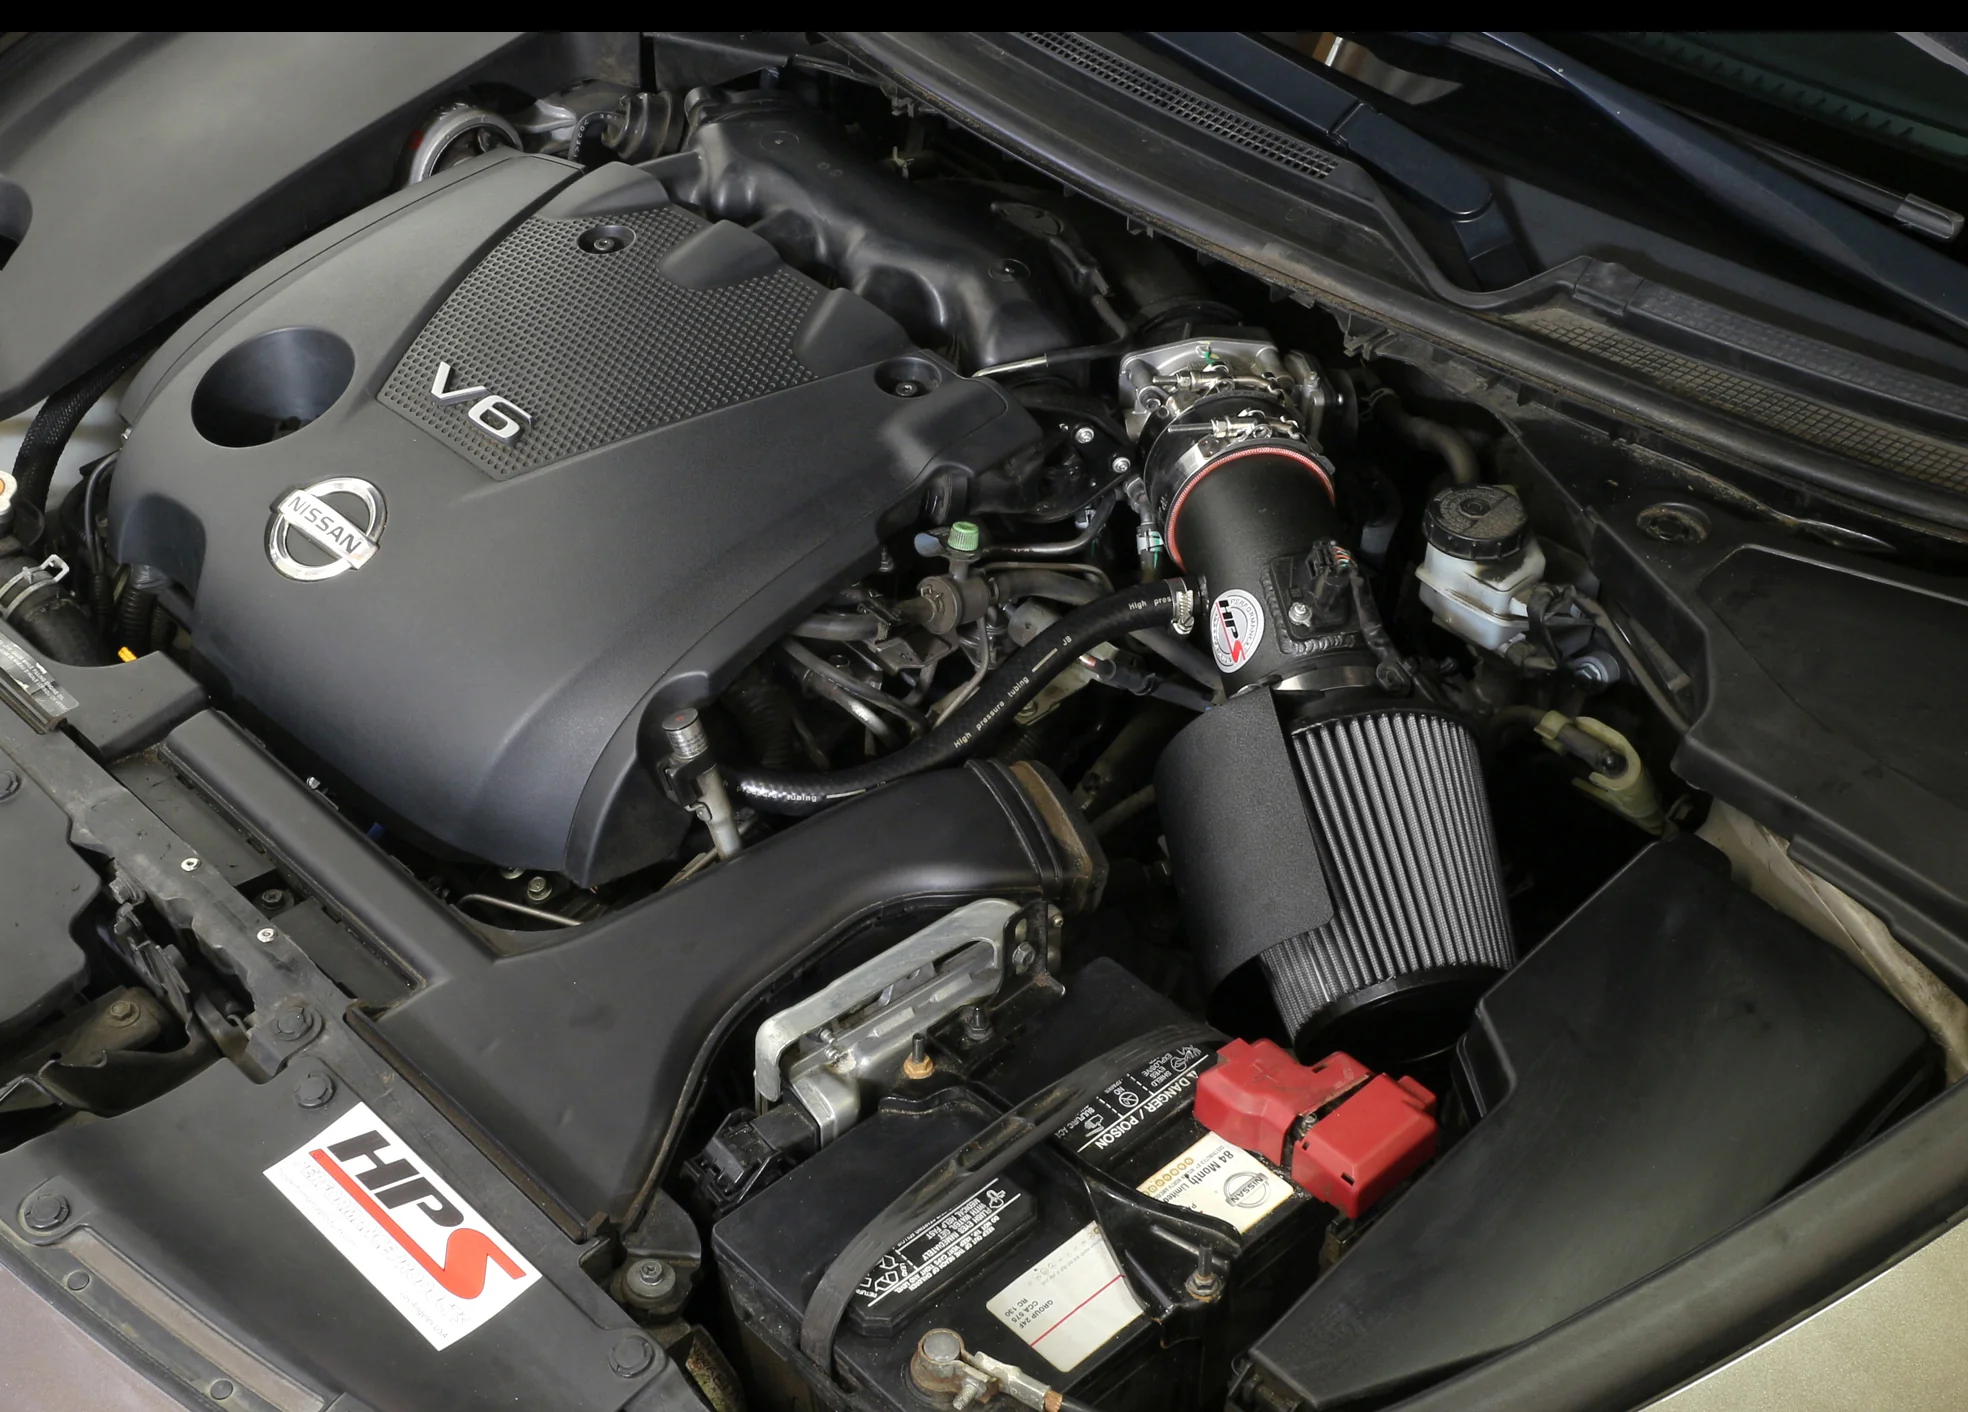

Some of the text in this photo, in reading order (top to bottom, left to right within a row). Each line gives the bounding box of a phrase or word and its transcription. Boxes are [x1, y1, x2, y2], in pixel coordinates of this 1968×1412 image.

[431, 361, 533, 444] V6
[289, 496, 362, 553] NISSAN
[1129, 597, 1171, 610] High pres
[1215, 600, 1246, 663] HPS
[954, 732, 972, 748] High
[976, 701, 1004, 731] pressure
[1007, 677, 1029, 697] tubing
[1141, 1053, 1172, 1077] EXPLOSIVE
[1150, 1066, 1166, 1079] EYES
[1113, 1086, 1125, 1095] NO
[1151, 1071, 1172, 1087] SHIELD
[1144, 1077, 1190, 1112] DANGER
[1095, 1115, 1139, 1149] POISON
[1218, 1150, 1234, 1163] 84
[1186, 1161, 1220, 1185] Month
[1230, 1174, 1264, 1203] NISSAN
[309, 1130, 526, 1299] HPS
[926, 1198, 981, 1240] MEDICAL HELP FAST
[969, 1203, 986, 1216] WITH
[991, 1215, 1000, 1223] DO
[922, 1207, 992, 1261] FLUSH EYES IMMEDIATELY
[938, 1229, 951, 1240] GET
[981, 1221, 992, 1231] NOT
[947, 1245, 960, 1256] VENT
[960, 1236, 972, 1247] KEEP
[909, 1226, 995, 1291] KEEP OUT OF THE REACH OF CHILDREN
[1004, 1298, 1028, 1317] RC 130
[1011, 1301, 1038, 1323] CCA 575
[1019, 1300, 1053, 1329] GROUP 24F
